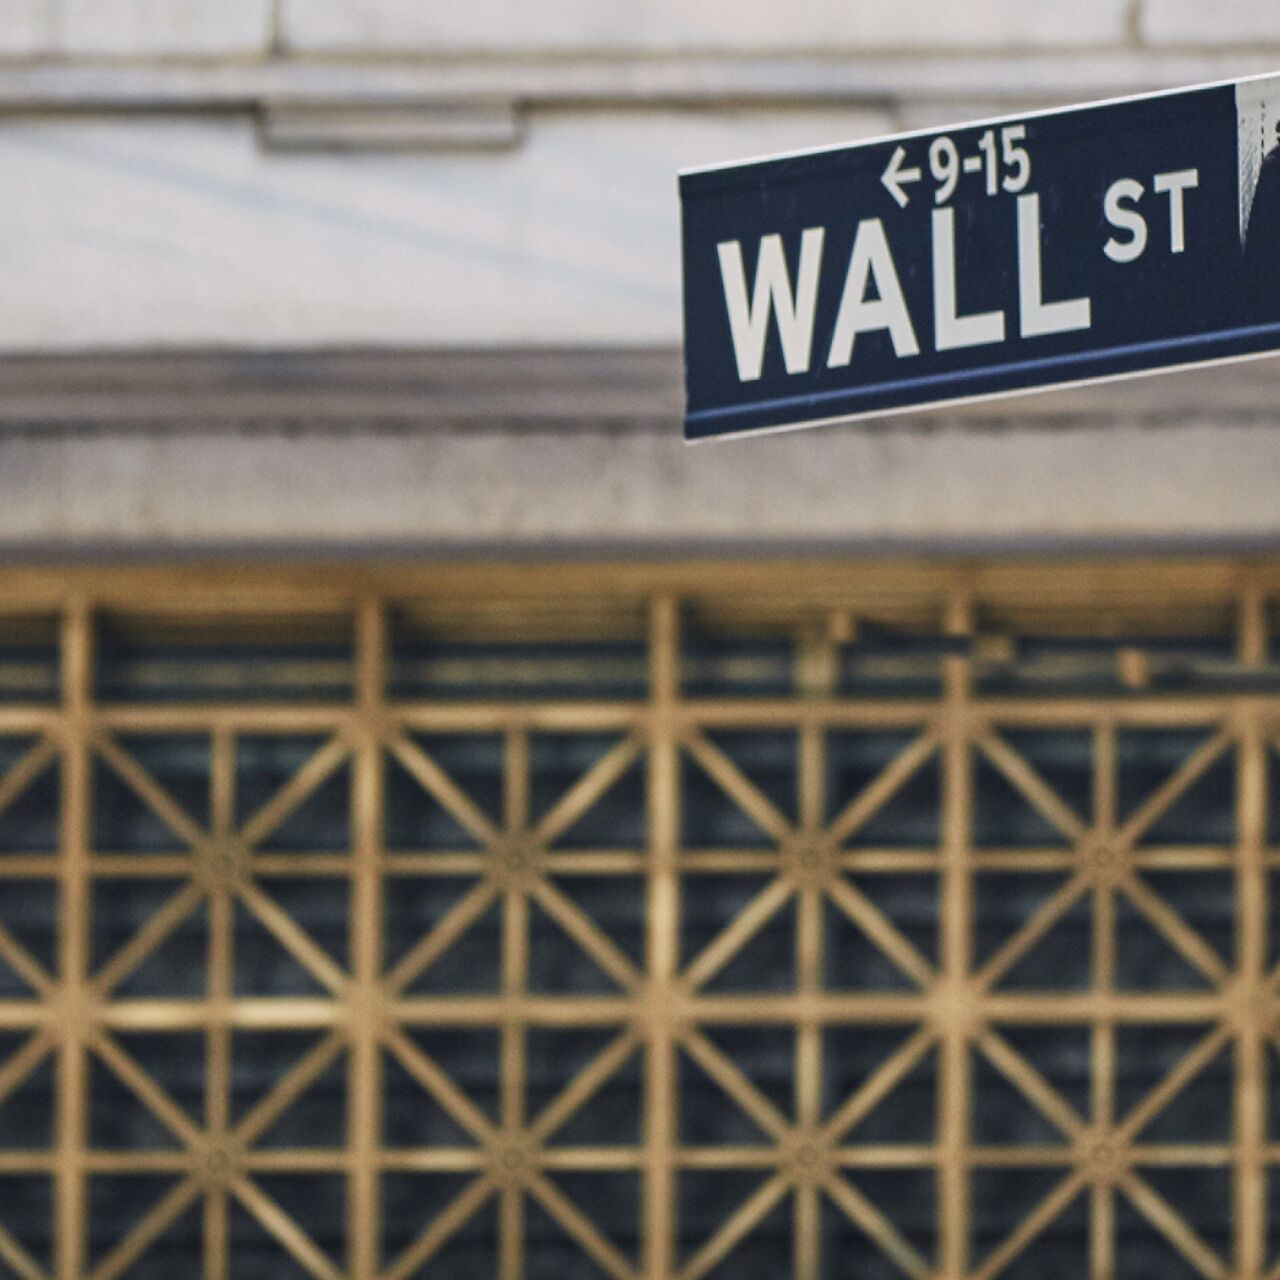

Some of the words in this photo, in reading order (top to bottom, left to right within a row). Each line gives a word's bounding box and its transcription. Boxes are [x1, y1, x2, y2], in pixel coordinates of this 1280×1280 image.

[929, 124, 1031, 205] 9-15
[716, 193, 1091, 382] WALL
[1103, 167, 1199, 263] ST
